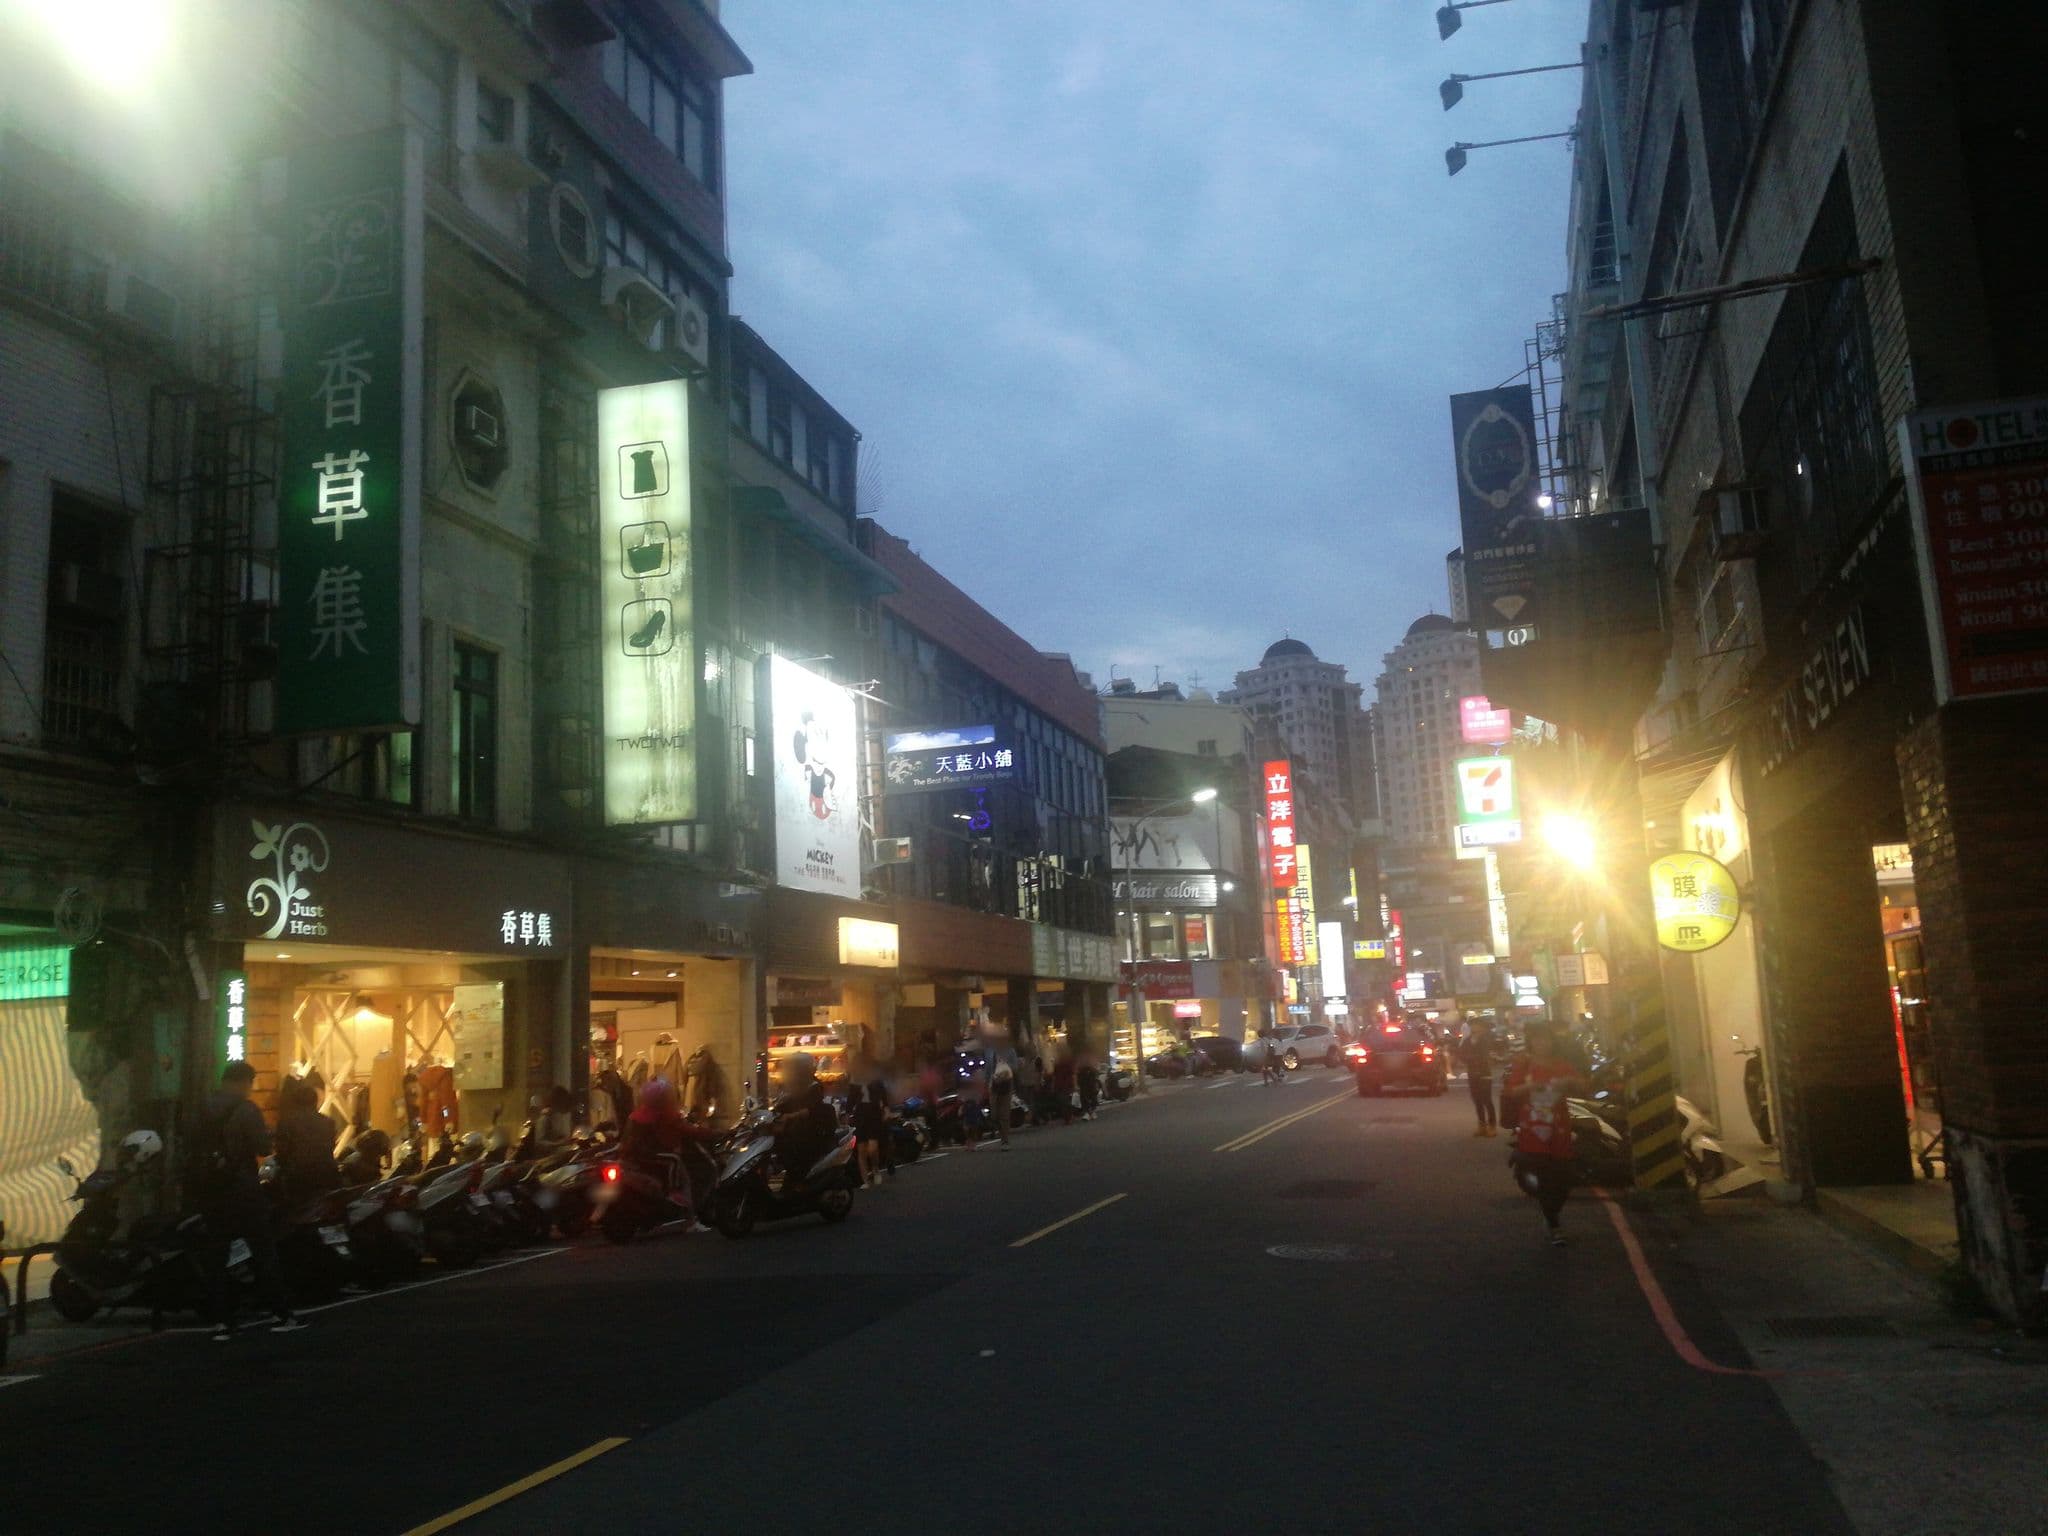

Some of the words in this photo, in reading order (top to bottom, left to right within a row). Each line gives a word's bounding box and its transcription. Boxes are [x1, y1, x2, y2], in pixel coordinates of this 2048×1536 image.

[1919, 412, 2034, 452] HOTEL
[310, 342, 372, 660] 香草集
[1803, 600, 1870, 730] SEVEN
[936, 749, 1013, 774] 天藍小舖
[1267, 773, 1296, 876] 立洋電子
[806, 849, 834, 866] MICKEY
[1130, 880, 1161, 899] hair
[1163, 879, 1201, 899] salon
[1673, 874, 1699, 898] 膜
[290, 902, 324, 918] Just
[290, 920, 328, 936] Herb
[500, 909, 553, 947] 香草集
[18, 964, 64, 985] ROSE
[227, 978, 245, 1062] 香草集
